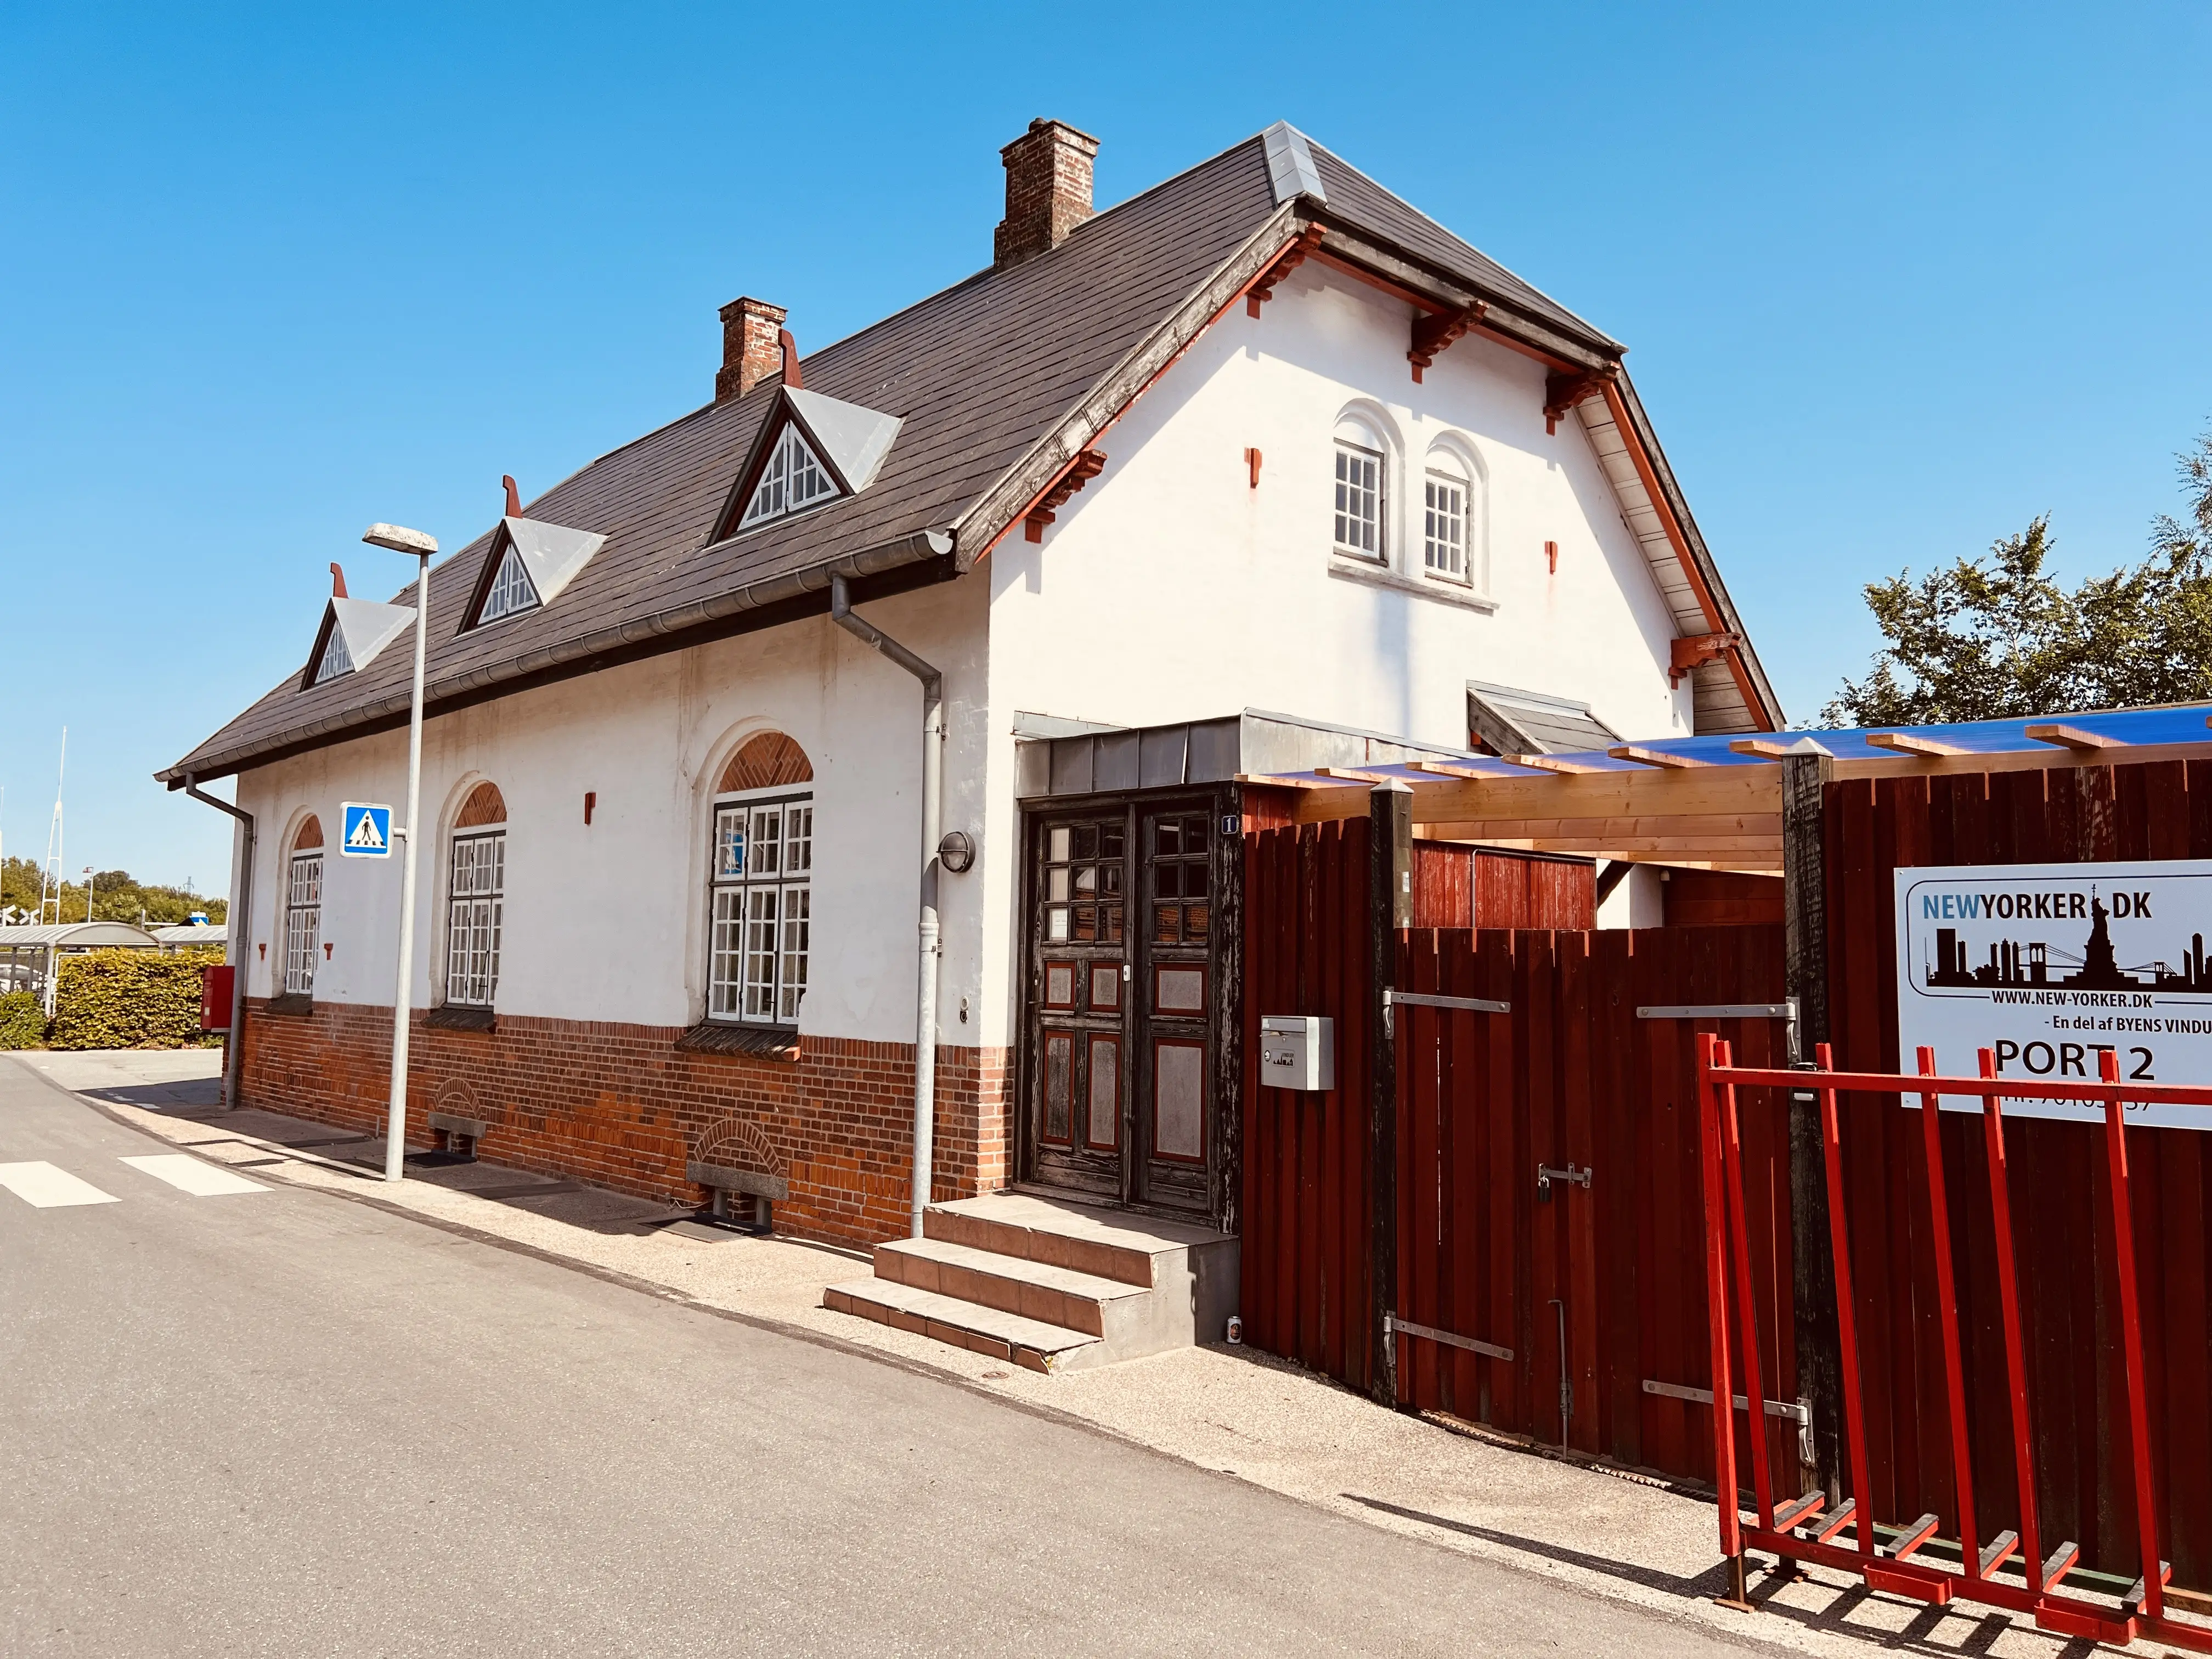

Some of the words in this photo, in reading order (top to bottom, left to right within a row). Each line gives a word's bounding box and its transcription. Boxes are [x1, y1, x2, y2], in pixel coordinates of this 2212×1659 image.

[1226, 817, 1232, 832] 1
[2113, 892, 2152, 919] DK
[1992, 991, 2153, 1008] WWW.NEW-YORKER.DK
[2053, 1015, 2069, 1029] En
[2073, 1016, 2094, 1029] del
[2098, 1017, 2113, 1030] af
[2117, 1018, 2162, 1032] BYENS
[2164, 1019, 2212, 1034] VINDU
[2129, 1047, 2154, 1080] 2
